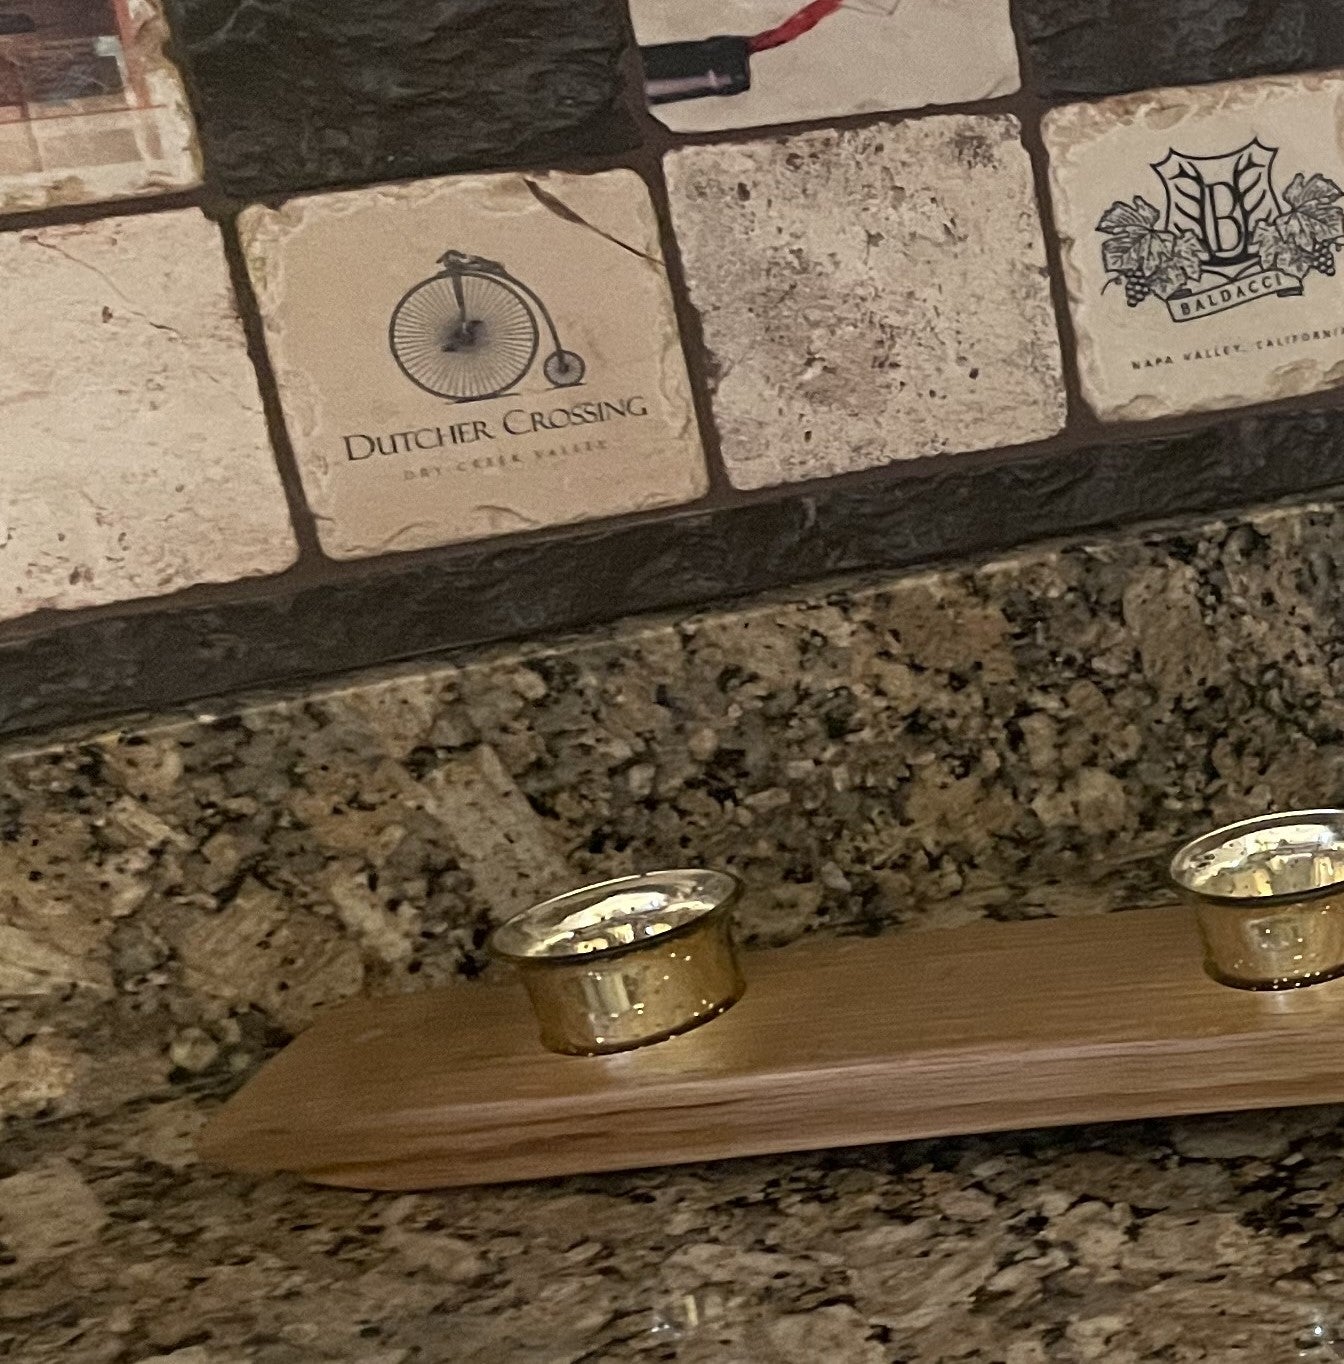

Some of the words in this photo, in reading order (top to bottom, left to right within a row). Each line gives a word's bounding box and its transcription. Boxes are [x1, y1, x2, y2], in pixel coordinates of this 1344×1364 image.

[1180, 273, 1283, 316] BALDACCI
[1131, 355, 1174, 370] NAPA
[342, 419, 495, 461] DUTCHER
[502, 396, 648, 435] CROSSING
[403, 466, 442, 481] DRY
[456, 453, 523, 472] CREEK
